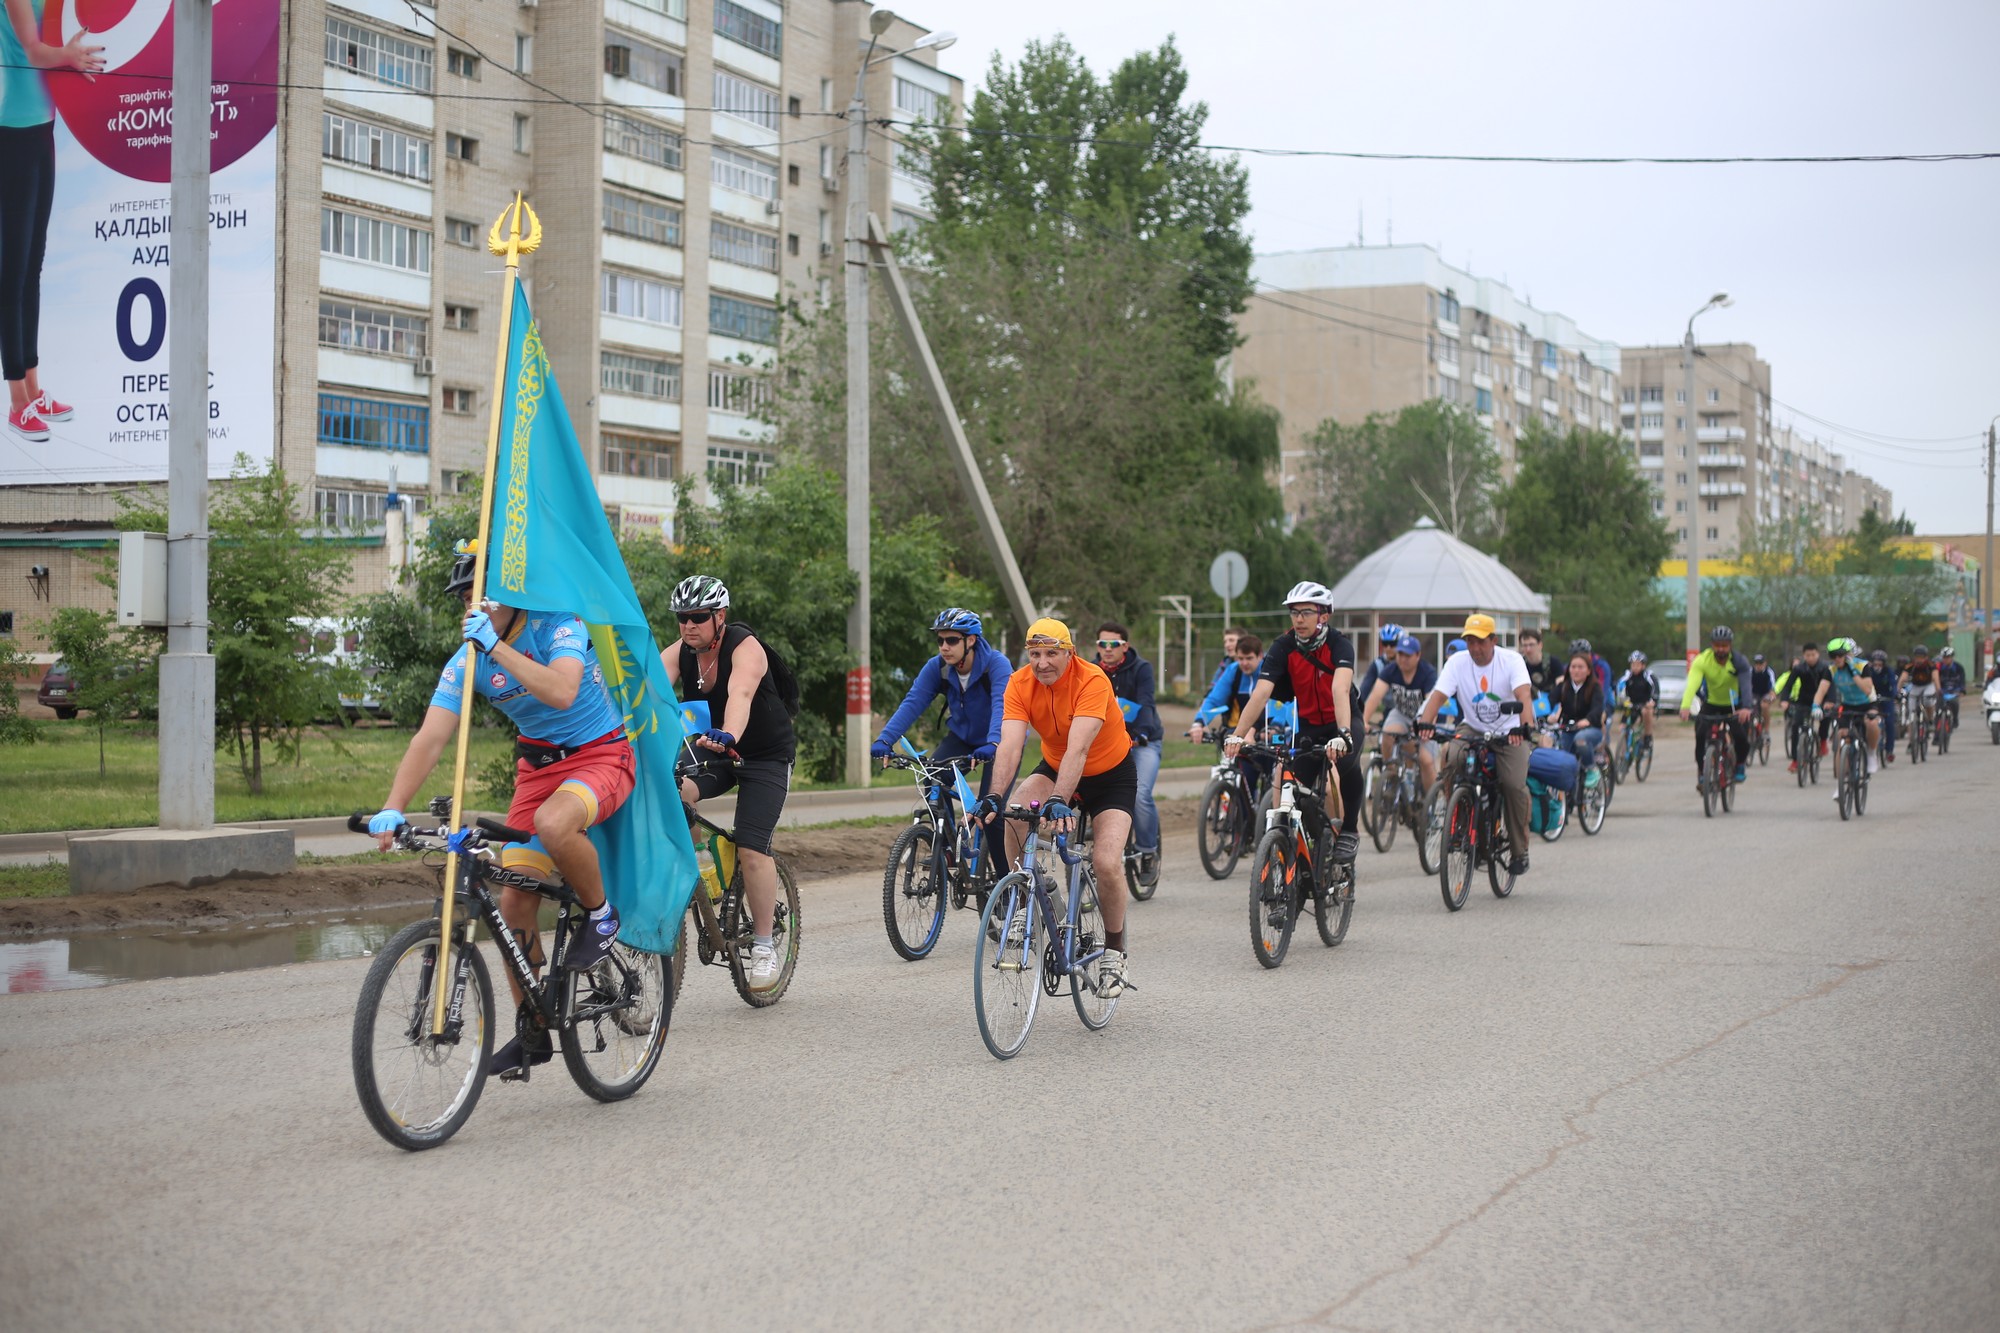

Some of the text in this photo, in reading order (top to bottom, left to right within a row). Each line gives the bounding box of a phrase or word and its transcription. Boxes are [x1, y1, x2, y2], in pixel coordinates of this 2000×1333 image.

[119, 88, 166, 106] тарифтік
[107, 100, 239, 132] «КОМТ»
[132, 245, 170, 267] АУД
[116, 277, 166, 362] 0
[122, 371, 214, 393] ПЕРЕС
[116, 401, 220, 423] ОСТАВ
[491, 909, 538, 989] MERIDA
